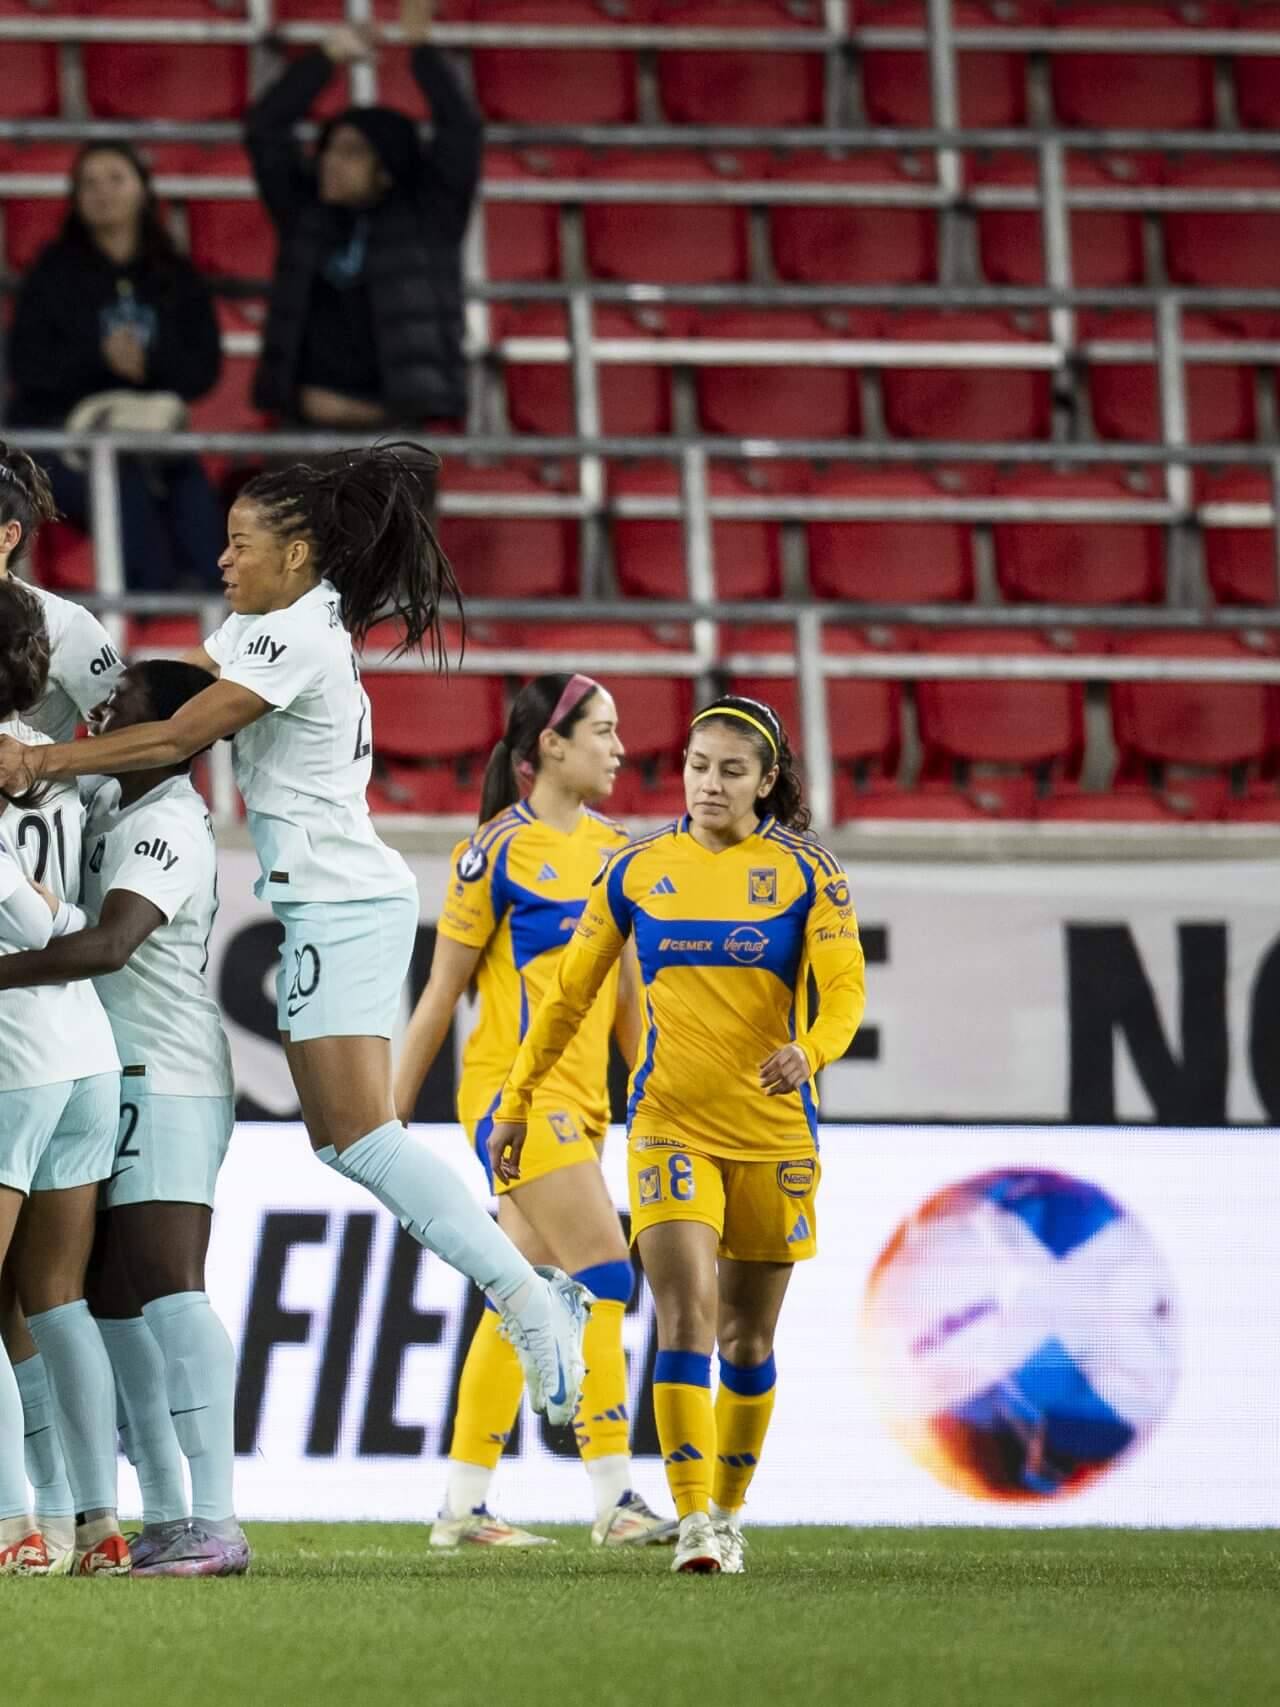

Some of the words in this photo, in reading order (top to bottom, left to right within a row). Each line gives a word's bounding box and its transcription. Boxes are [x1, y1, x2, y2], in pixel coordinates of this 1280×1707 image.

[89, 643, 120, 676] all
[15, 806, 66, 898] 21
[134, 837, 179, 872] ally
[670, 939, 713, 952] CEMEX
[668, 1152, 695, 1201] 8
